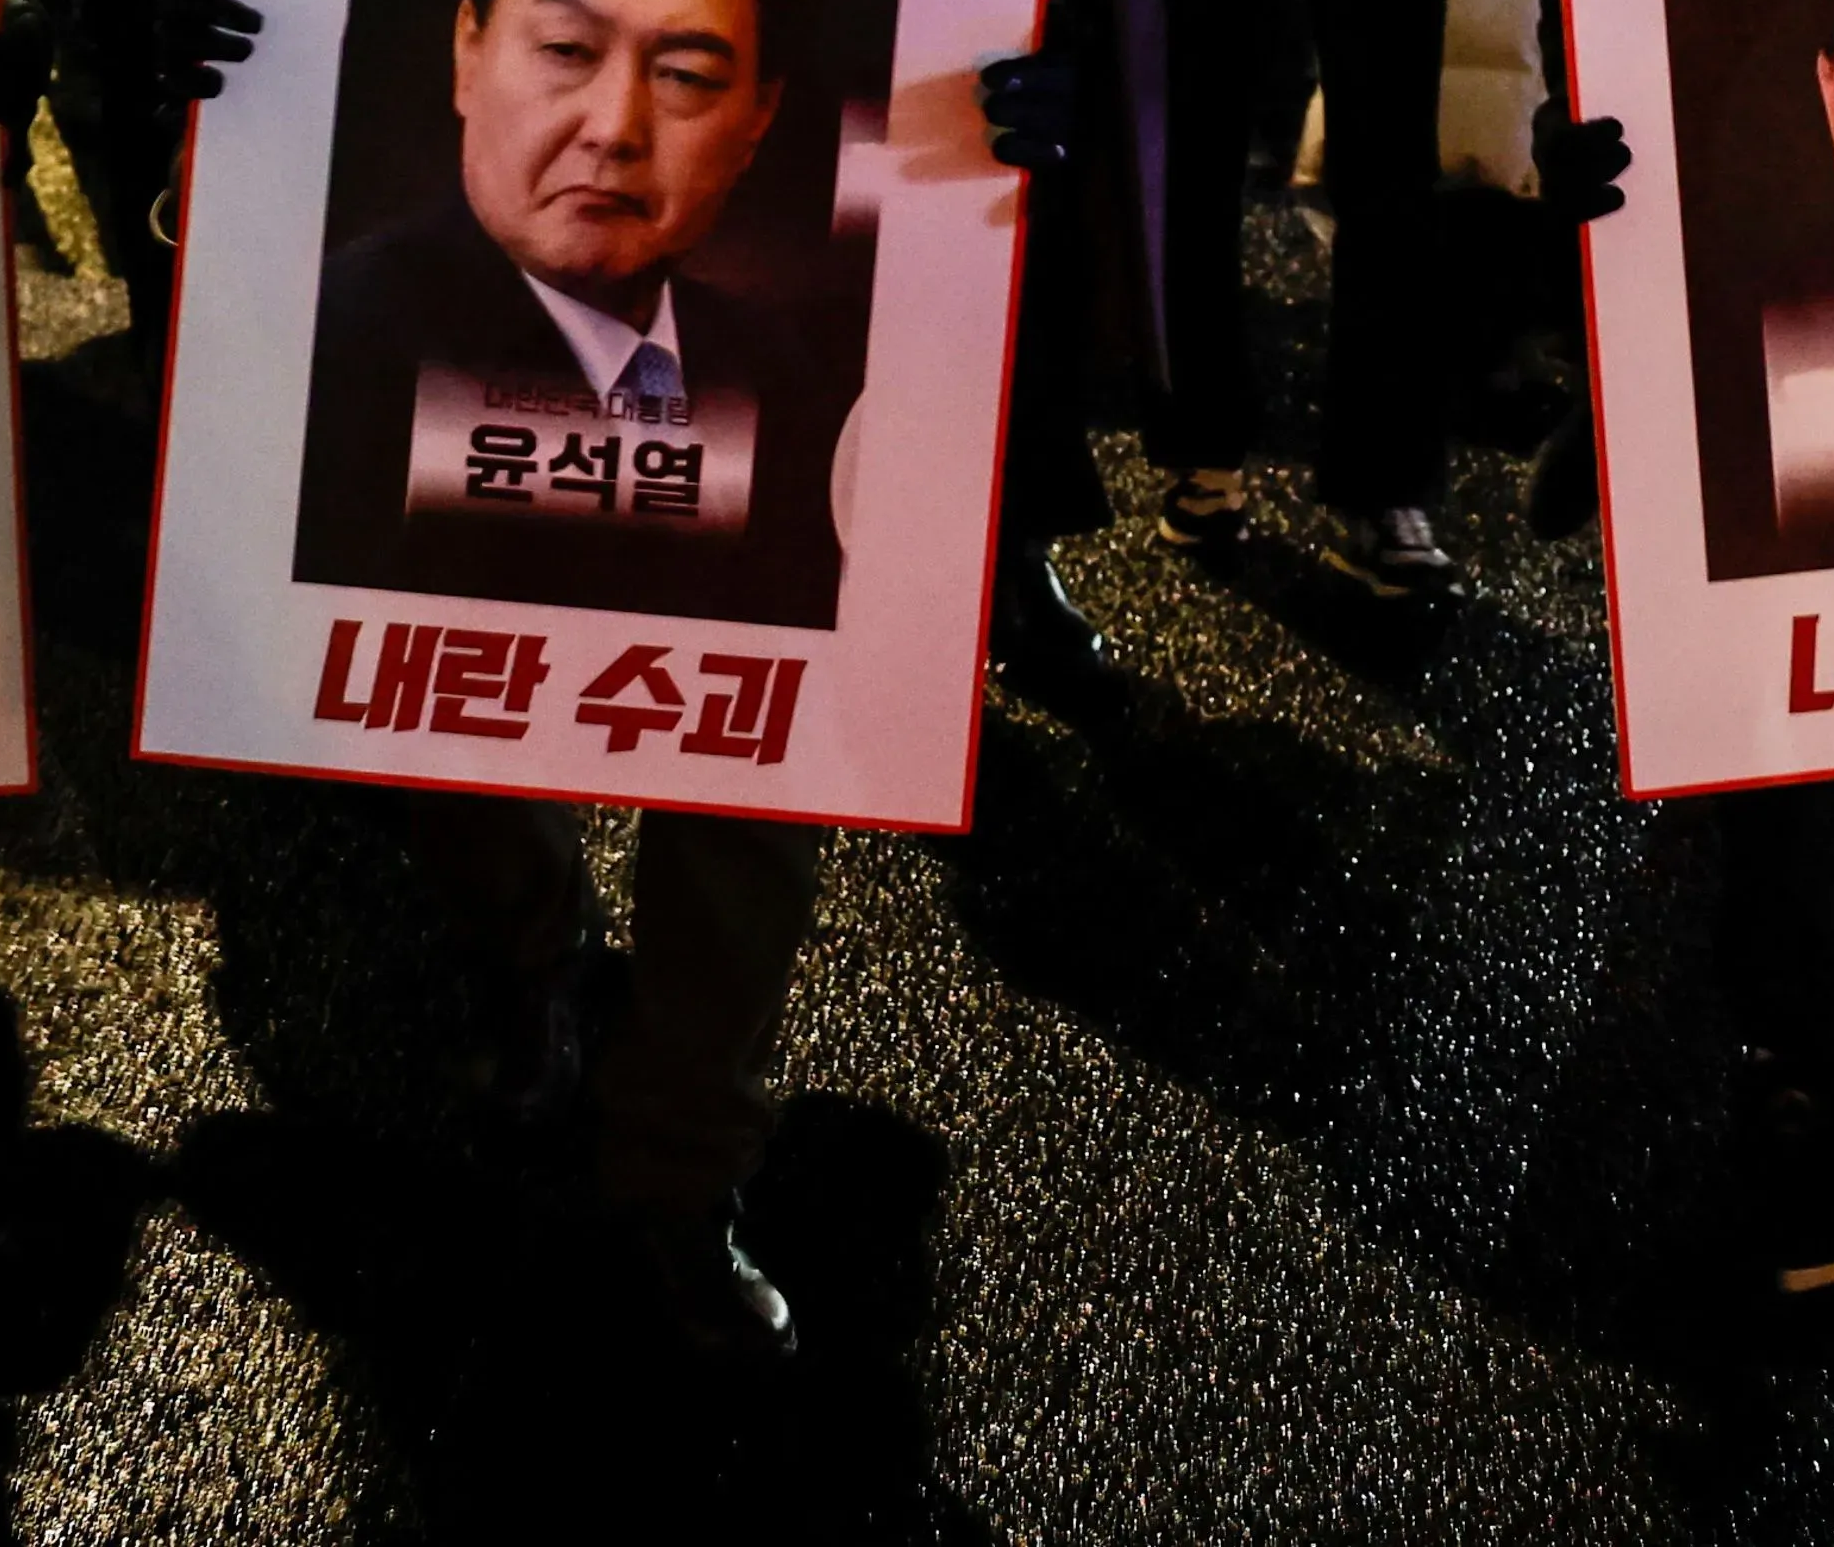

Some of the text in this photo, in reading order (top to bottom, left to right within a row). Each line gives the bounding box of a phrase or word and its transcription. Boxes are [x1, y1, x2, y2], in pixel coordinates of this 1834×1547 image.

[465, 423, 706, 517] 윤석열
[313, 619, 808, 766] 내란 수괴
